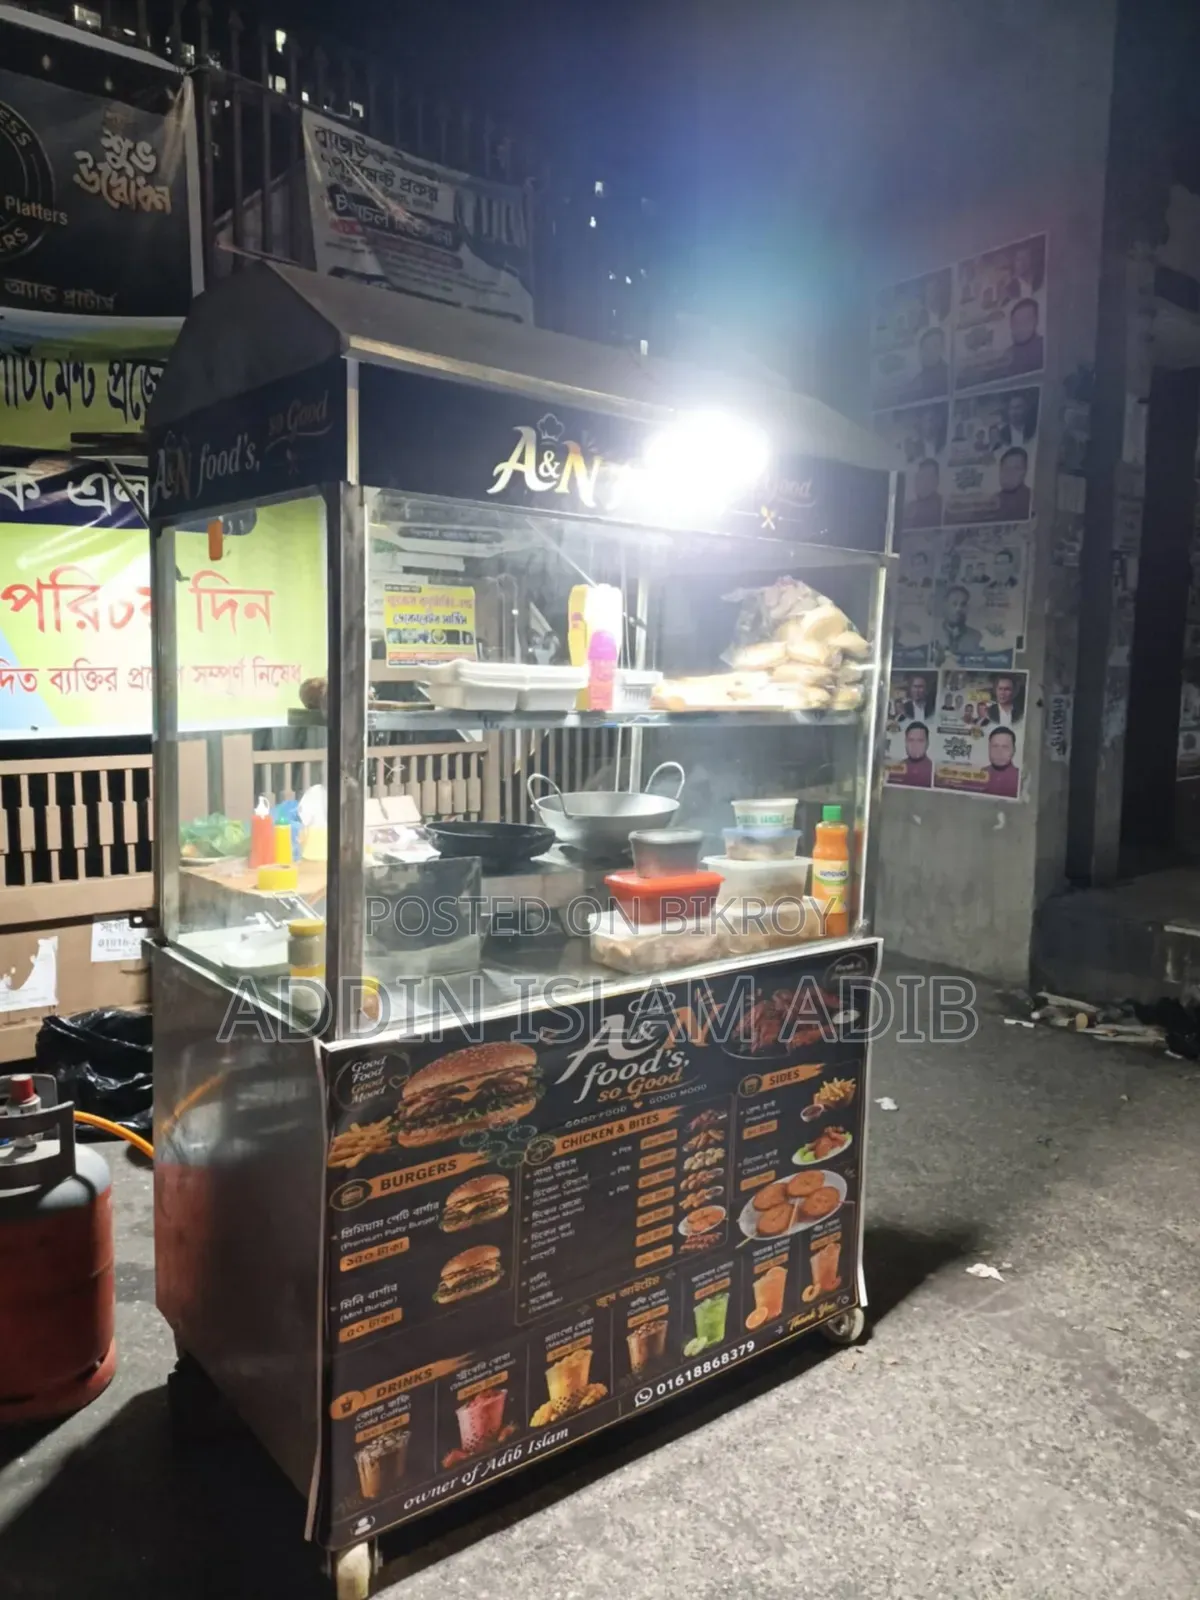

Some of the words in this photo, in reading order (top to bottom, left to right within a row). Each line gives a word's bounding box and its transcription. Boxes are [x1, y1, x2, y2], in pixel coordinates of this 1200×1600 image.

[4, 195, 68, 226] Platters
[188, 568, 277, 635] দিন
[47, 657, 118, 695] ব্যক্তির
[351, 1055, 388, 1073] Good
[351, 1067, 385, 1084] Food
[573, 1048, 690, 1104] food's,
[769, 1069, 800, 1086] SIDES
[597, 1087, 622, 1102] so
[627, 1067, 683, 1100] Good
[561, 1127, 614, 1150] CHICKEN
[617, 1122, 626, 1134] &
[629, 1112, 660, 1130] BITES
[380, 1160, 458, 1191] BURGERS
[376, 1368, 433, 1398] DRINKS
[656, 1340, 755, 1395] 01618868379
[403, 1475, 458, 1510] owner
[461, 1460, 484, 1486] of
[482, 1444, 522, 1477] Adib
[527, 1427, 569, 1455] Islam
